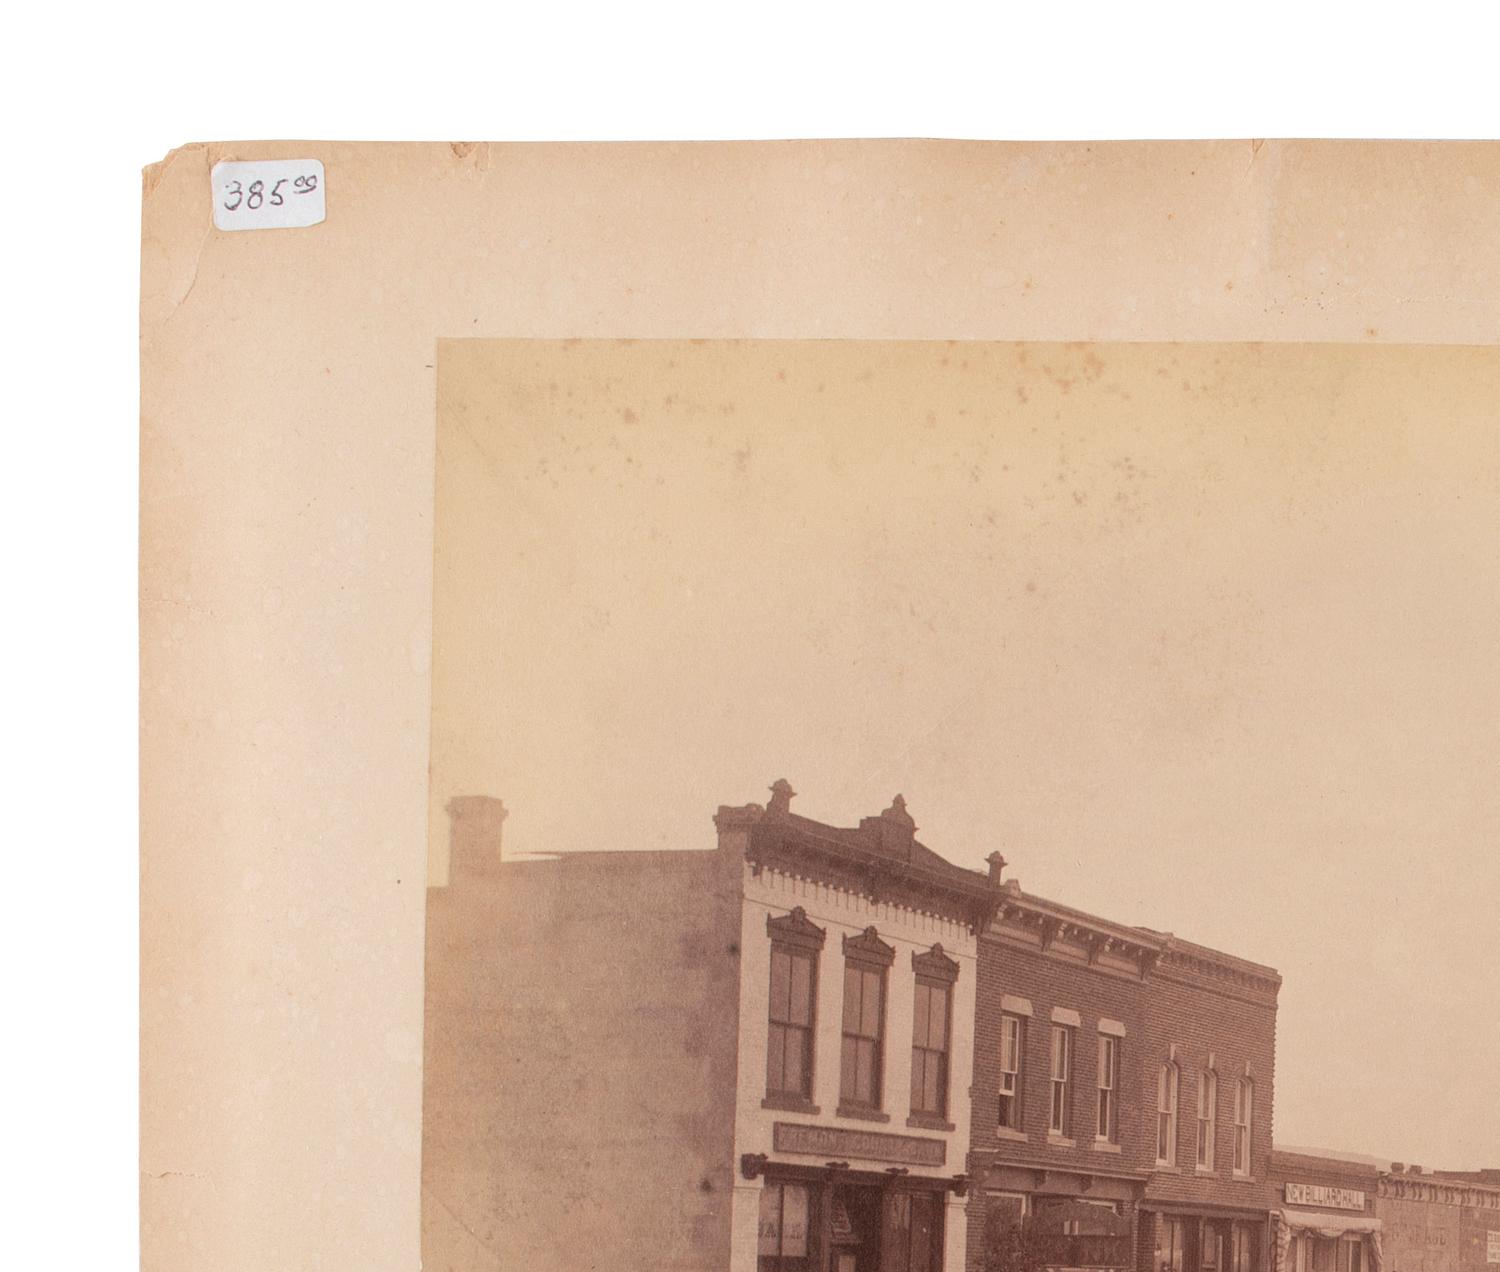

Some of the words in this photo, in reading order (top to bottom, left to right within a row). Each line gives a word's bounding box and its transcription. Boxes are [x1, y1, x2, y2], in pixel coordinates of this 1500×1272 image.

[1286, 1184, 1304, 1202] NEW
[1305, 1185, 1342, 1206] BILLIARD
[1343, 1190, 1362, 1209] HALL
